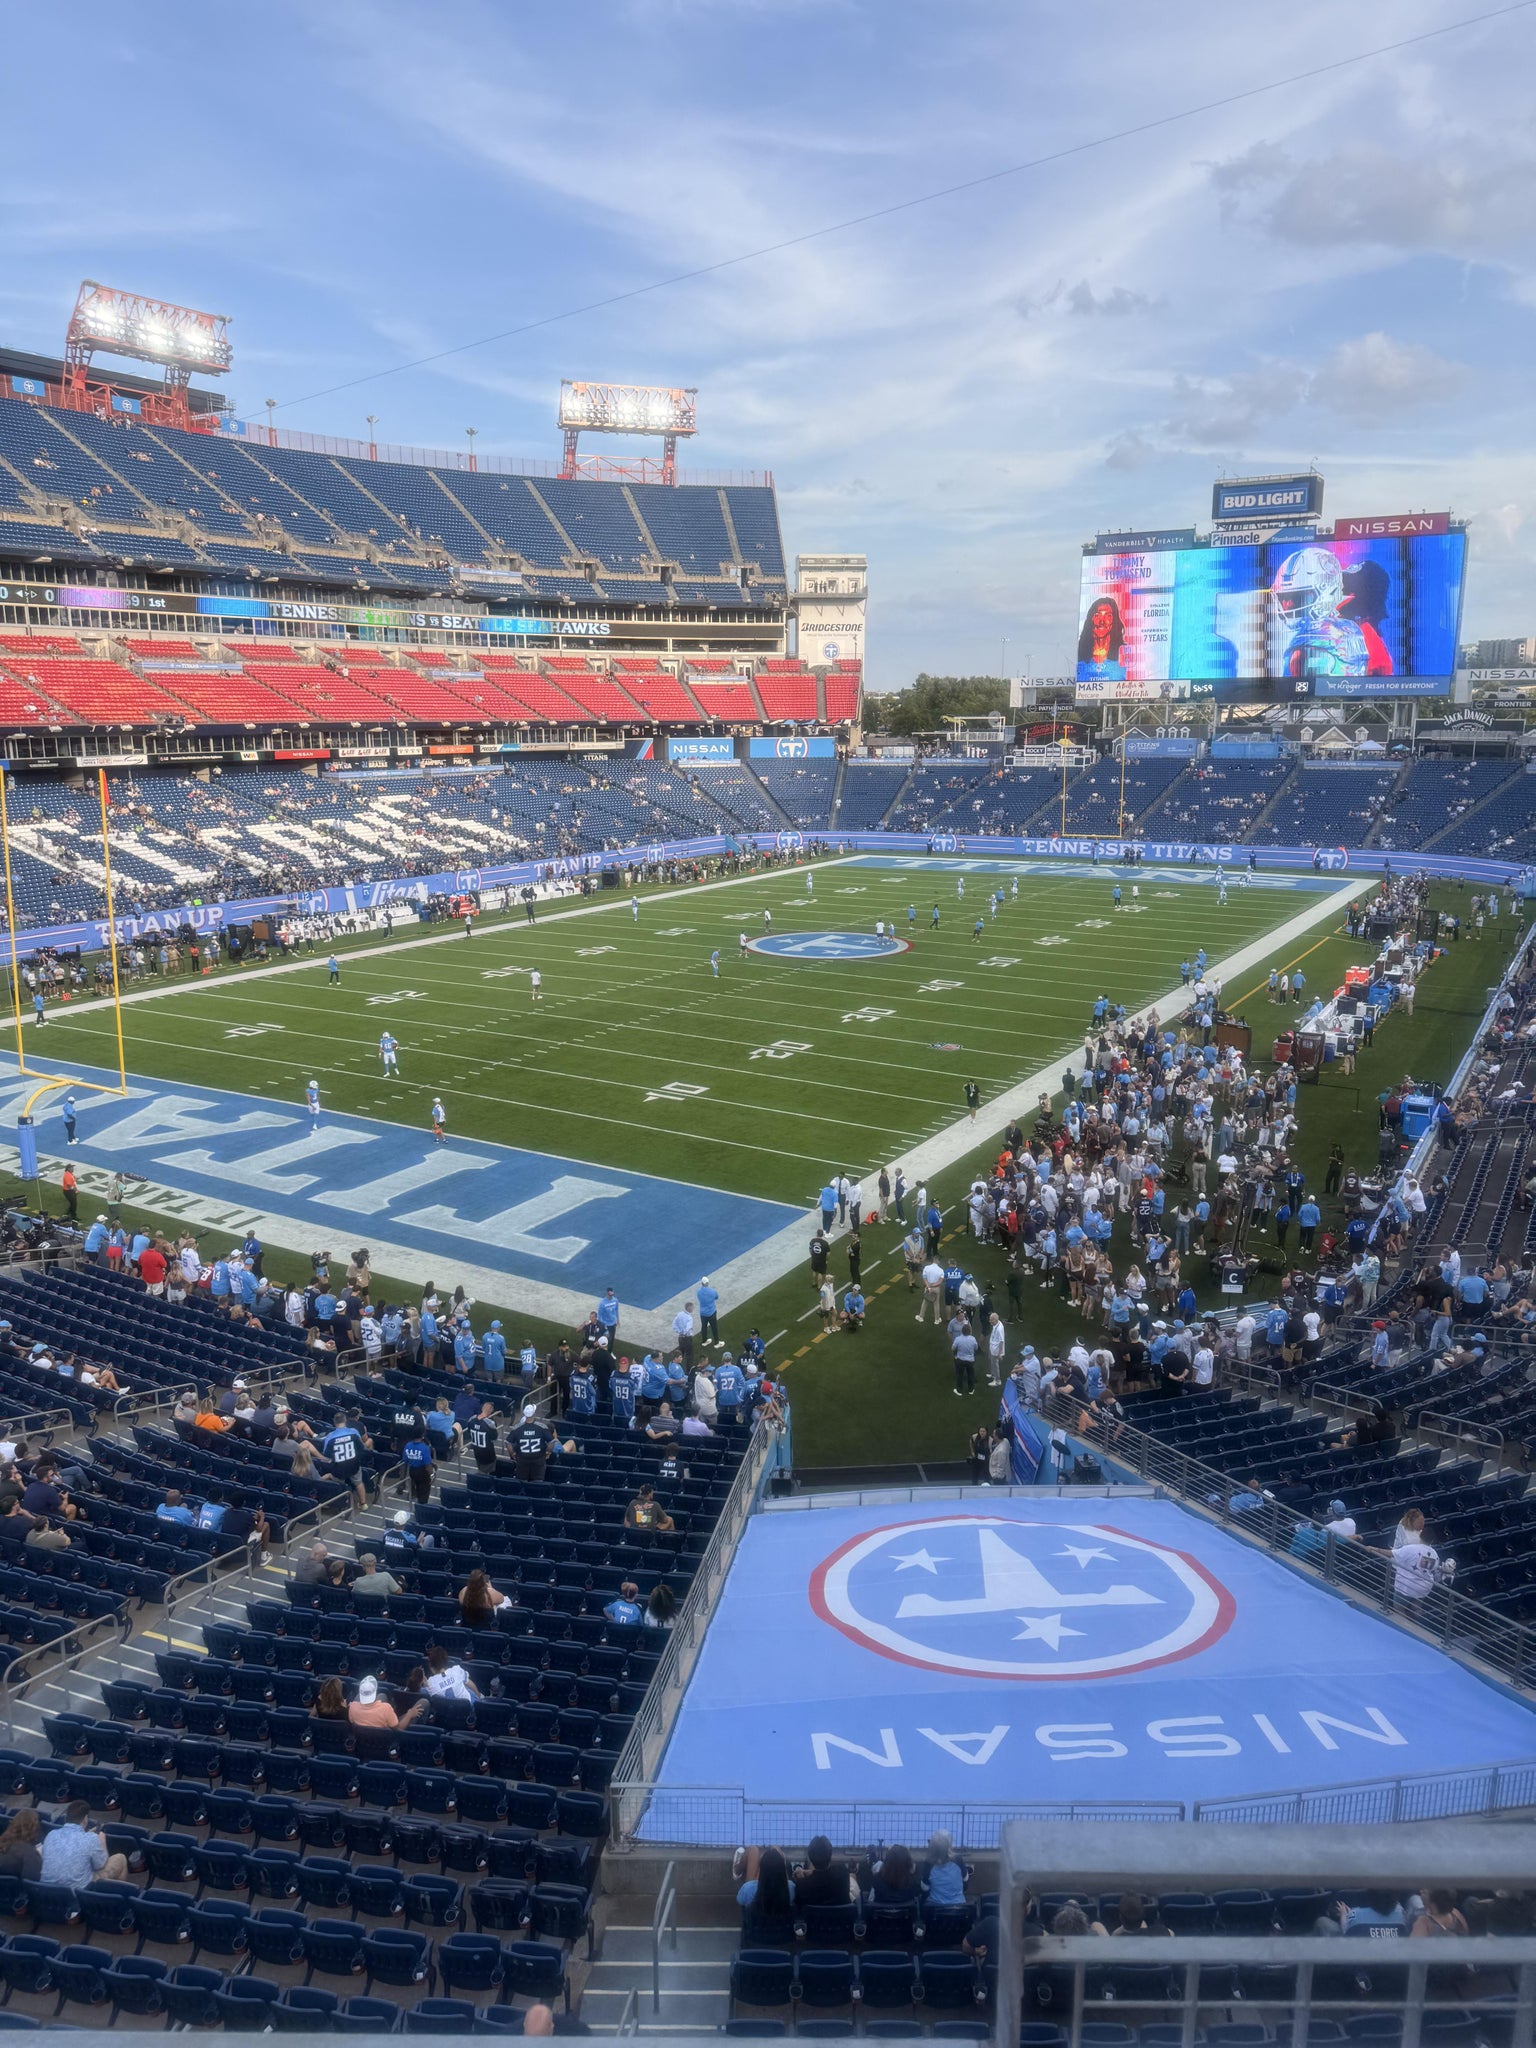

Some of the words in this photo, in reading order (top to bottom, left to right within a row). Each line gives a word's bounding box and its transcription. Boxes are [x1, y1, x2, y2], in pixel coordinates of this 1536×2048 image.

[1224, 494, 1256, 508] BUD
[1258, 491, 1304, 506] LIGHT
[1350, 519, 1433, 534] NISSAN
[1105, 539, 1145, 548] VANDERBILT
[1157, 537, 1184, 545] HEALTH
[1212, 532, 1260, 545] Pinnacle
[1113, 556, 1146, 568] TOMMY
[1104, 567, 1151, 581] TOWNSEND
[45, 589, 54, 602] 0
[149, 597, 165, 608] 1st
[1143, 607, 1170, 618] FLORIDA
[516, 619, 611, 635] SEAHAWKS
[801, 622, 864, 632] BRIDGESTONE
[1144, 634, 1148, 643] 7
[1149, 633, 1168, 643] YEARS
[1020, 678, 1076, 686] NISSAN
[1078, 682, 1104, 692] MARS
[1337, 680, 1361, 693] Kroger
[1443, 712, 1464, 726] JACK
[1464, 708, 1495, 727] DANIEL'S
[673, 744, 729, 753] NISSAN
[1023, 839, 1147, 857] TENNESSEE
[1152, 844, 1233, 861] TITANS
[582, 855, 602, 870] UP
[95, 911, 182, 943] TITAN
[187, 907, 224, 929] UP
[977, 956, 1022, 968] 50
[919, 979, 965, 992] 40
[366, 989, 429, 1004] 20
[842, 1006, 897, 1022] 30
[225, 1022, 285, 1036] 10
[751, 1039, 814, 1059] 20
[645, 1081, 710, 1101] 10
[1139, 1206, 1150, 1215] 22
[201, 1209, 266, 1230] IT
[1229, 1272, 1238, 1284] C
[1274, 1321, 1285, 1333] 14
[488, 1344, 492, 1355] 1
[521, 1353, 531, 1363] 28
[721, 1377, 735, 1390] 27
[574, 1384, 587, 1399] 93
[334, 1441, 356, 1462] 28
[520, 1438, 541, 1453] 22
[439, 1677, 454, 1689] WARD
[810, 1707, 1408, 1769] NISSAN
[1370, 1927, 1398, 1938] GEORGE
